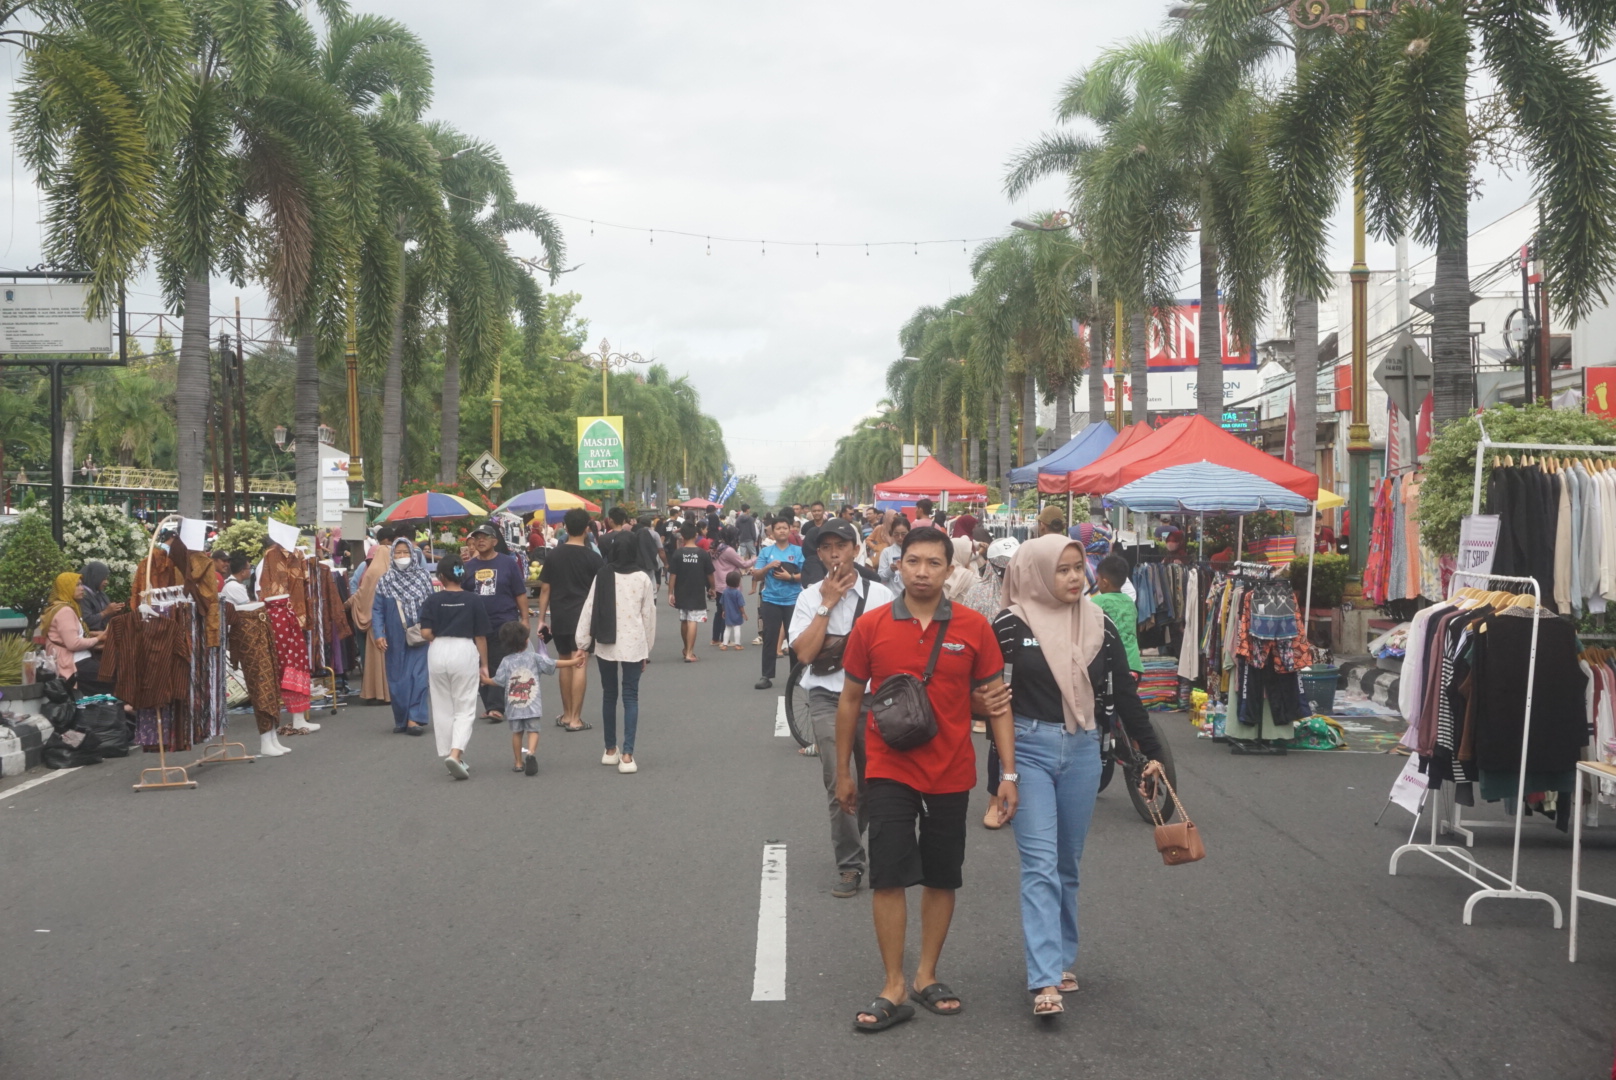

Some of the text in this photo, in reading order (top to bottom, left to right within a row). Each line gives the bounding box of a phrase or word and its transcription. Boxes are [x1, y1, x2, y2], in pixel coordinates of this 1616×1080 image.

[583, 438, 619, 447] MASJID
[590, 449, 611, 458] RAYA
[584, 459, 619, 469] KLATEN
[1471, 550, 1490, 568] SHOP
